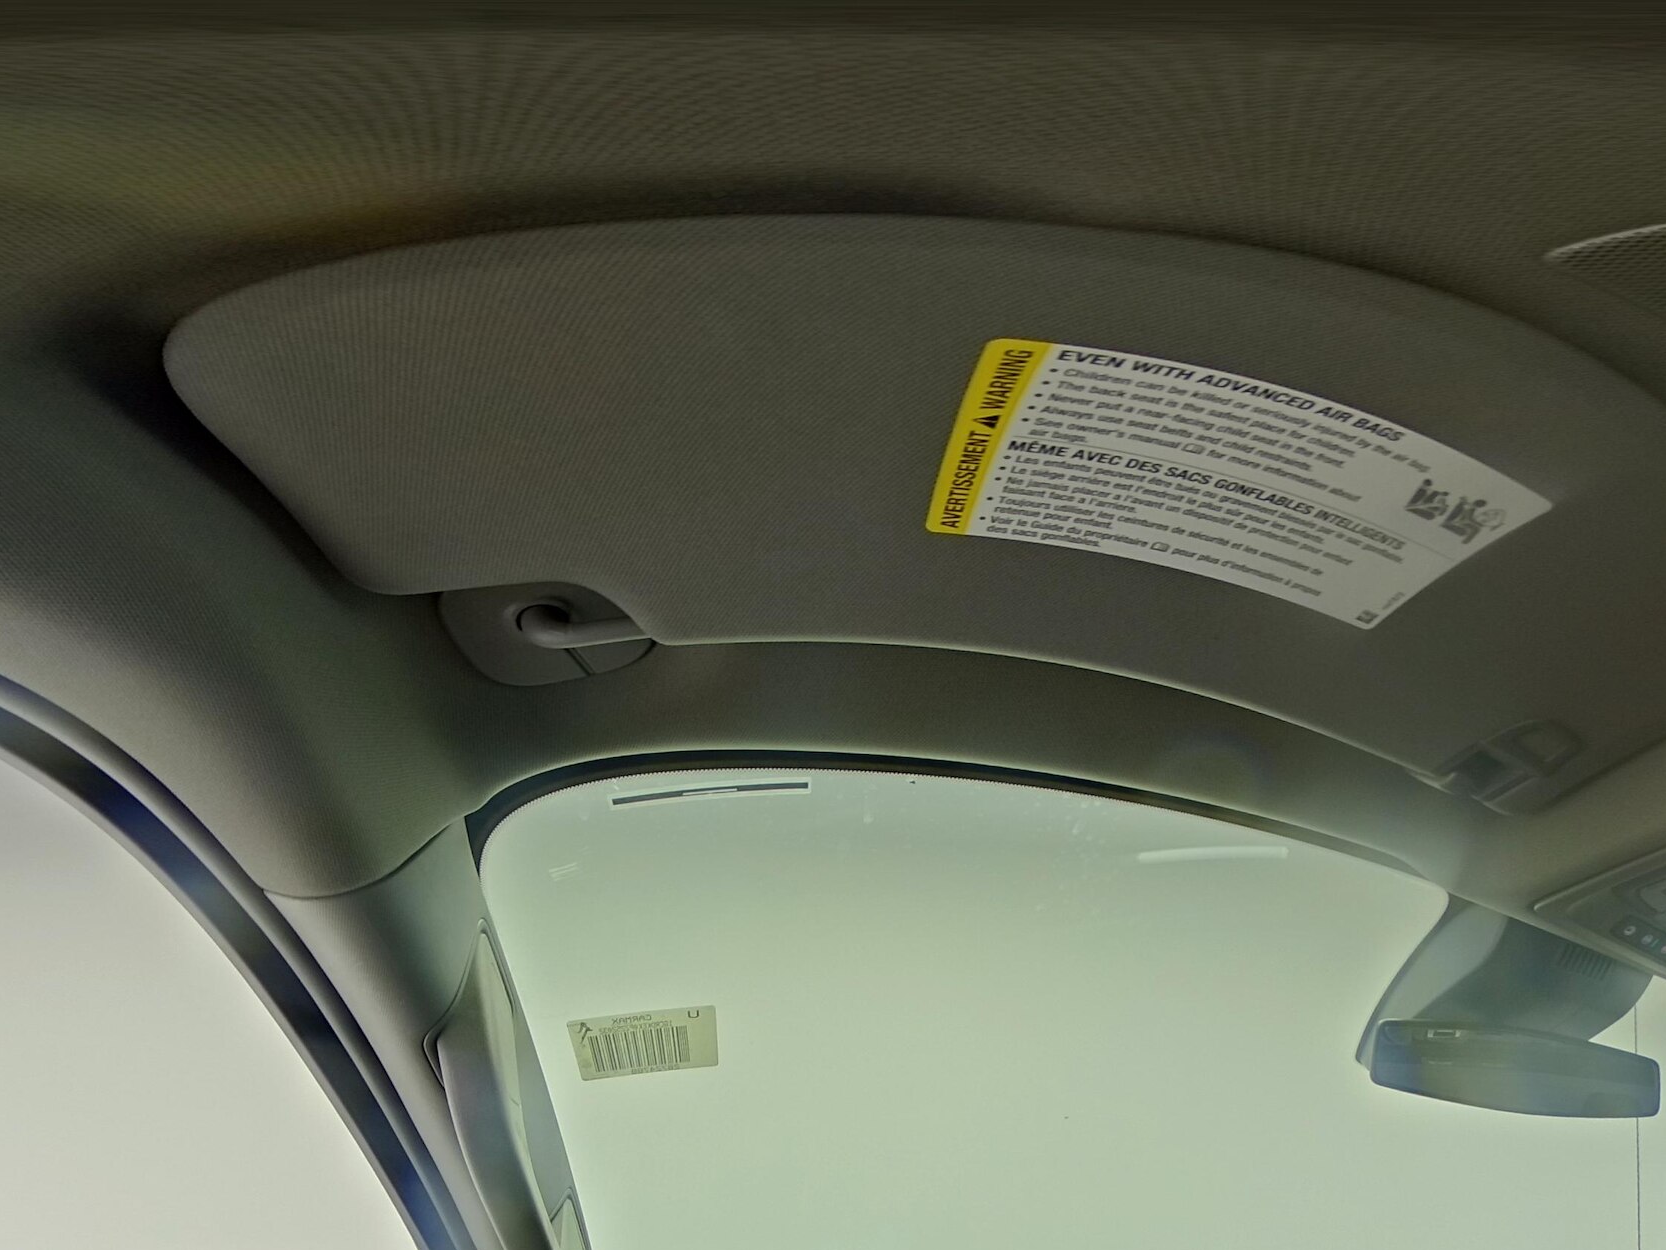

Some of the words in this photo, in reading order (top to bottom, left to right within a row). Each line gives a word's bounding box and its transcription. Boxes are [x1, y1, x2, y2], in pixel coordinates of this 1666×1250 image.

[979, 349, 1034, 410] WARNING
[1058, 350, 1127, 368] EVEN
[1132, 361, 1196, 380] WITH
[1197, 375, 1316, 410] ADVANCED
[1315, 407, 1352, 422] AIR
[1352, 418, 1406, 442] BAGS
[1063, 368, 1132, 385] Children
[1135, 381, 1166, 391] can
[1167, 386, 1188, 396] be
[1190, 391, 1232, 405] killed
[1251, 407, 1311, 428] seriously
[1047, 393, 1095, 406] Never
[1095, 402, 1123, 412] put
[1136, 408, 1216, 431] rear-facing
[1215, 426, 1251, 438] child
[1249, 435, 1281, 446] seat
[1057, 381, 1085, 392] The
[1088, 386, 1127, 398] back
[1130, 394, 1161, 404] seat
[1165, 399, 1179, 408] is
[1181, 402, 1205, 413] the
[1207, 409, 1251, 424] safest
[1249, 419, 1287, 434] place
[1034, 418, 1064, 428] See
[1067, 423, 1125, 438] owner's
[1127, 432, 1182, 449] manual
[1207, 450, 1227, 459] for
[1040, 406, 1095, 419] Always
[1097, 416, 1124, 424] use
[1126, 419, 1158, 431] seat
[1159, 426, 1194, 439] belts
[1195, 434, 1223, 445] and
[1222, 441, 1256, 453] child
[941, 431, 992, 528] AVERTISSEMENT
[1006, 477, 1024, 485] Ne
[1025, 478, 1070, 492] jamais
[1071, 487, 1112, 499] placer
[1011, 466, 1027, 474] Le
[1113, 482, 1134, 492] est
[1015, 455, 1039, 465] Les
[1043, 460, 1093, 472] enfants
[1093, 468, 1148, 482] peuvent
[994, 506, 1041, 518] retenue
[1043, 512, 1072, 522] pour
[999, 496, 1051, 510] Toujours
[1053, 503, 1096, 516] utiliser
[1098, 511, 1116, 519] les
[1116, 515, 1170, 531] ceintures
[1002, 486, 1046, 498] faisant
[1048, 492, 1075, 502] face
[1007, 441, 1069, 457] MÊME
[1071, 449, 1123, 465] AVEC
[1125, 458, 1163, 473] DES
[1164, 467, 1213, 484] SACS
[1214, 479, 1315, 515] GONFLABLES
[1314, 509, 1407, 550] INTELLIGENTS
[986, 525, 1008, 533] des
[1011, 528, 1038, 538] sacs
[990, 515, 1015, 525] Voir
[1017, 519, 1027, 527] le
[1031, 521, 1065, 532] Guide
